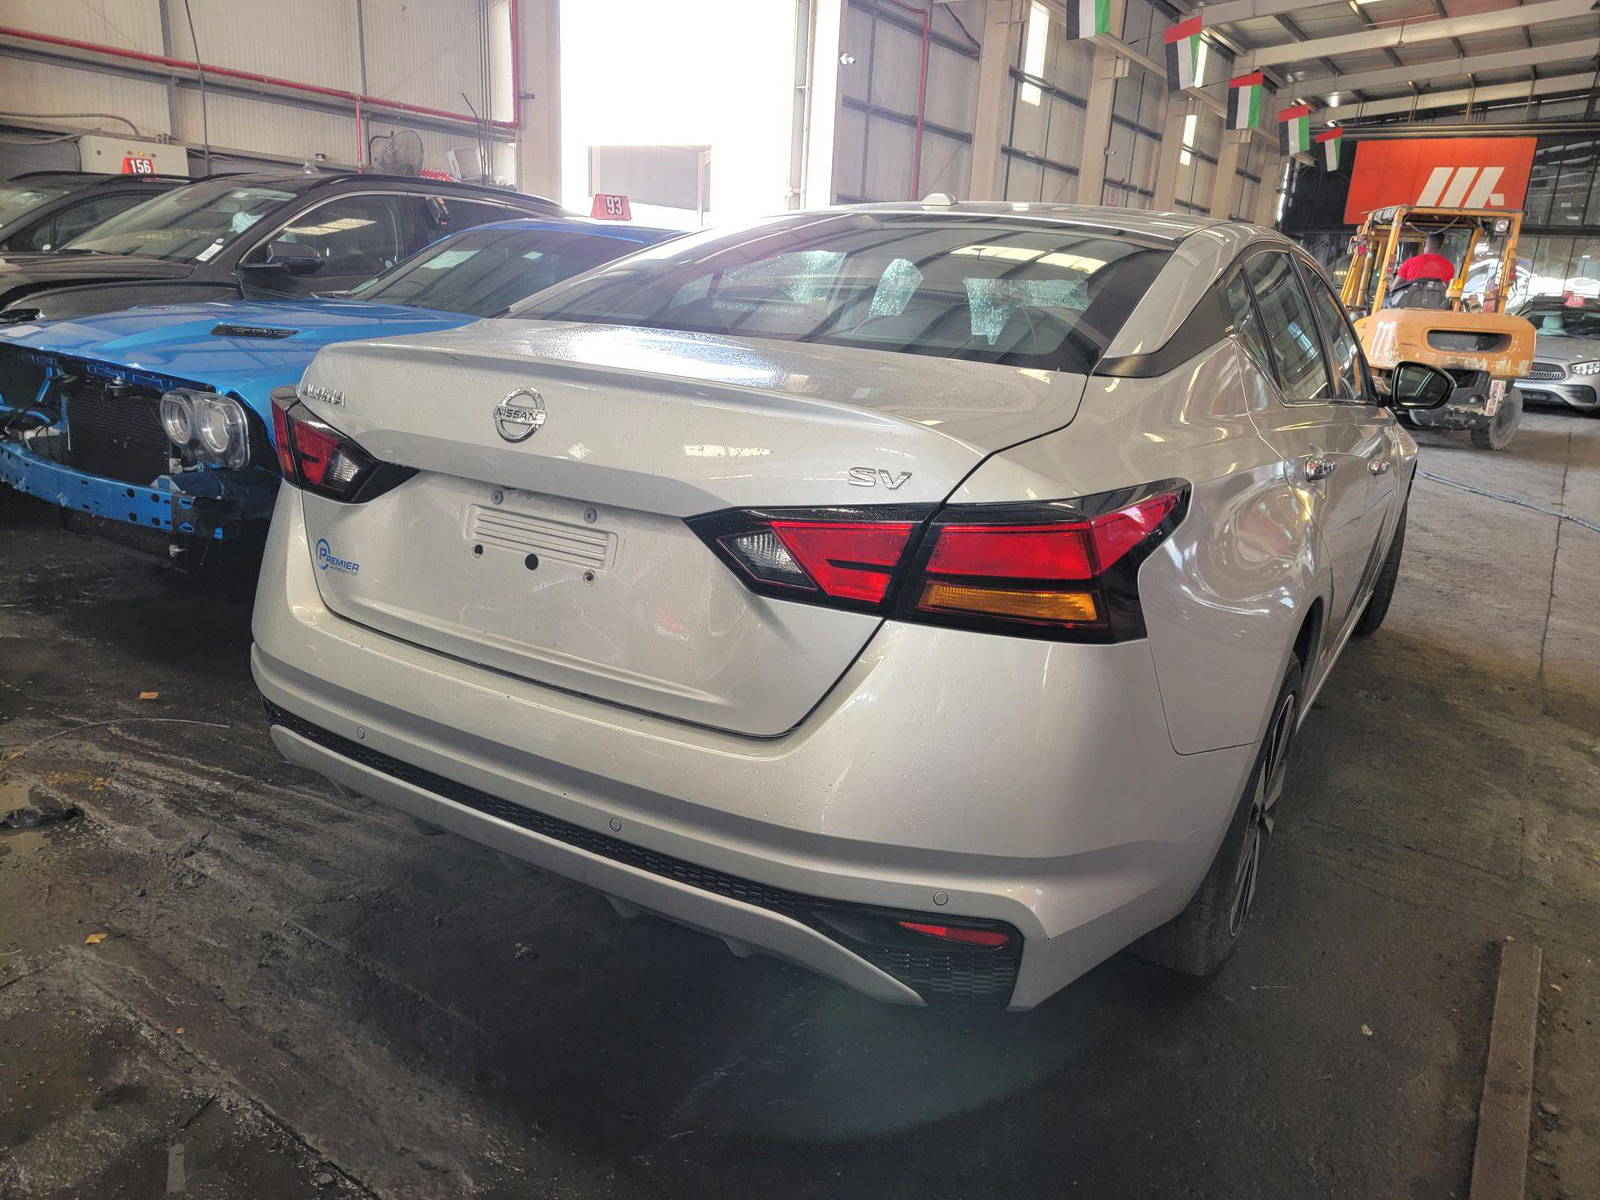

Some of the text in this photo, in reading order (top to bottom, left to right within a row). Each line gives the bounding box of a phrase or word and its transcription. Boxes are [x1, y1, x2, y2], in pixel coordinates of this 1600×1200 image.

[131, 159, 152, 174] 156
[606, 196, 623, 215] 93
[496, 407, 537, 421] NISSAN
[848, 466, 912, 490] SV
[319, 547, 360, 572] PREMIER
